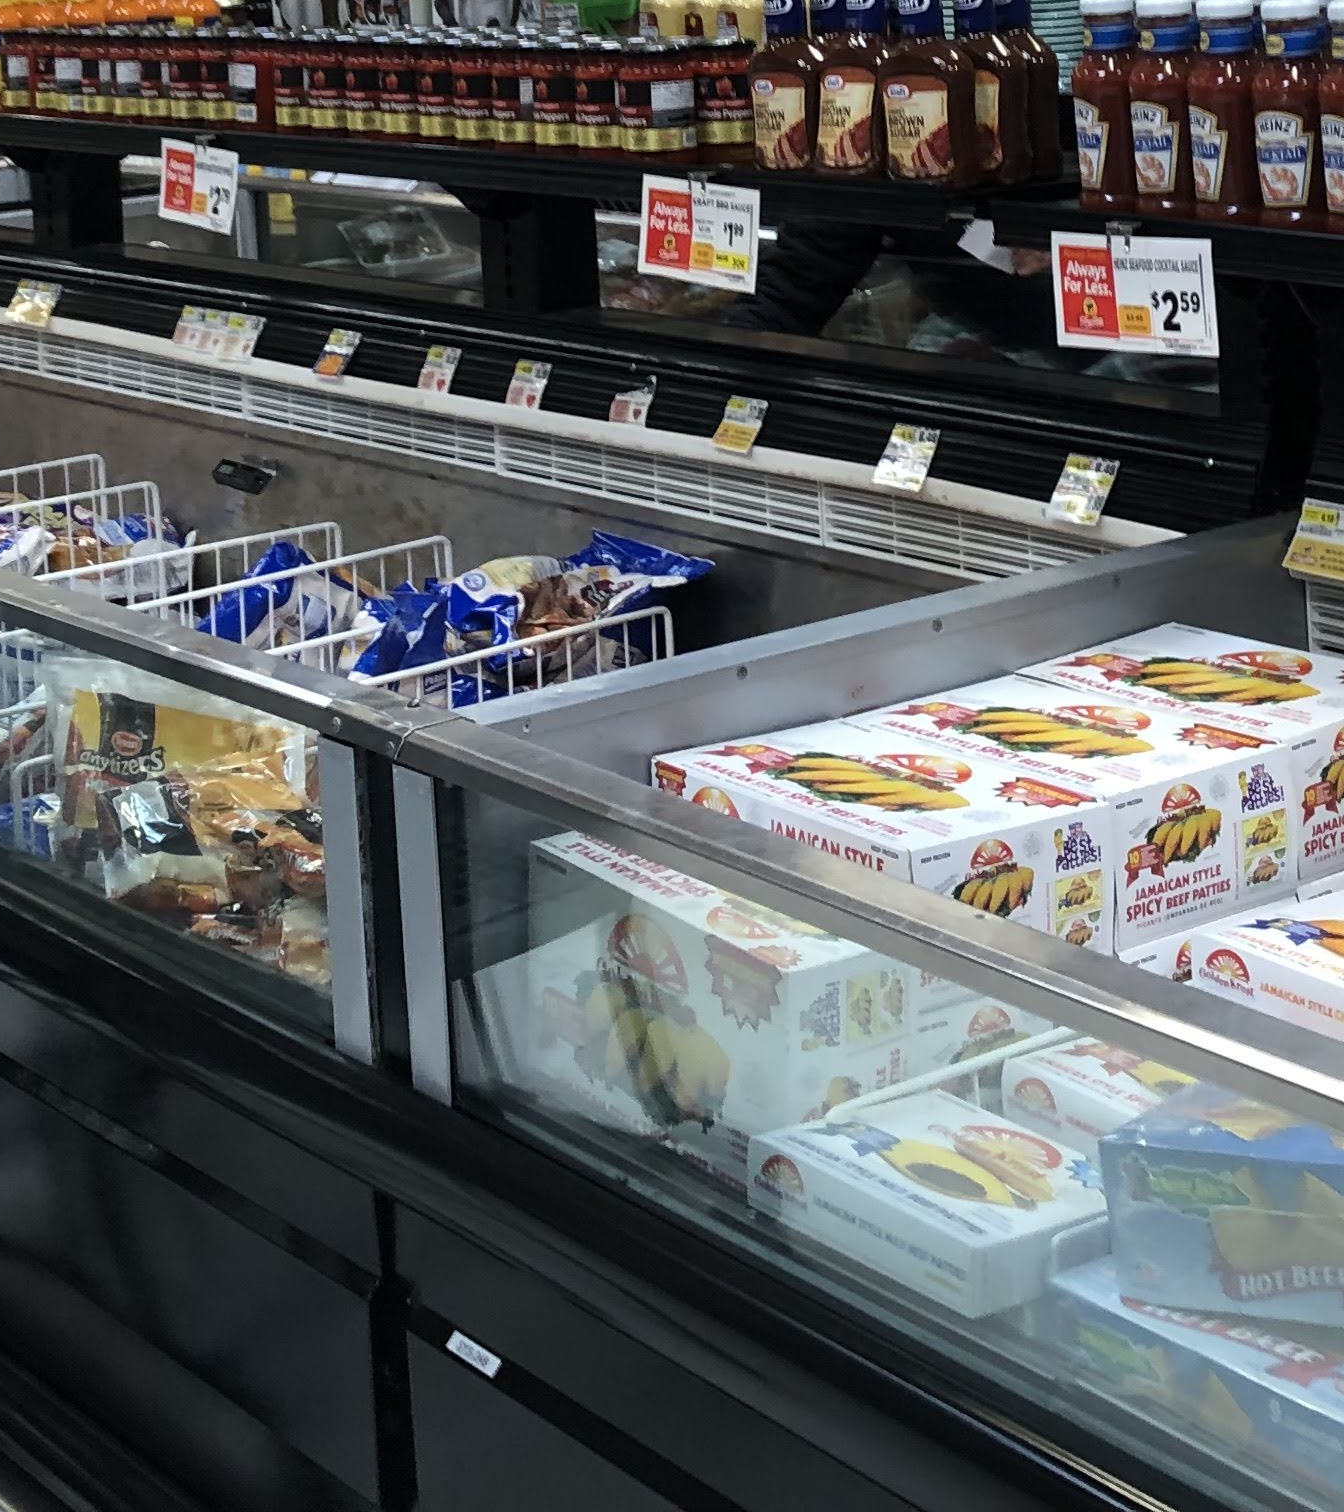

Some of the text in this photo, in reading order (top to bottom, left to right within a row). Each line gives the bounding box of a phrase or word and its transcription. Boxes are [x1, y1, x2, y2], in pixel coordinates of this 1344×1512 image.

[650, 215, 666, 231] For
[653, 201, 688, 220] Always
[1066, 260, 1106, 280] Always
[1064, 277, 1112, 297] For Less.
[1304, 831, 1336, 857] SPICY
[1135, 865, 1222, 902] JAMAICAN STYLE
[1126, 896, 1162, 923] SPICY
[1165, 891, 1190, 909] BEEF
[1191, 879, 1231, 905] PATTIES
[1259, 982, 1305, 1008] JAMAICAN
[1307, 1000, 1333, 1019] STYLE
[1240, 1269, 1286, 1297] HOT
